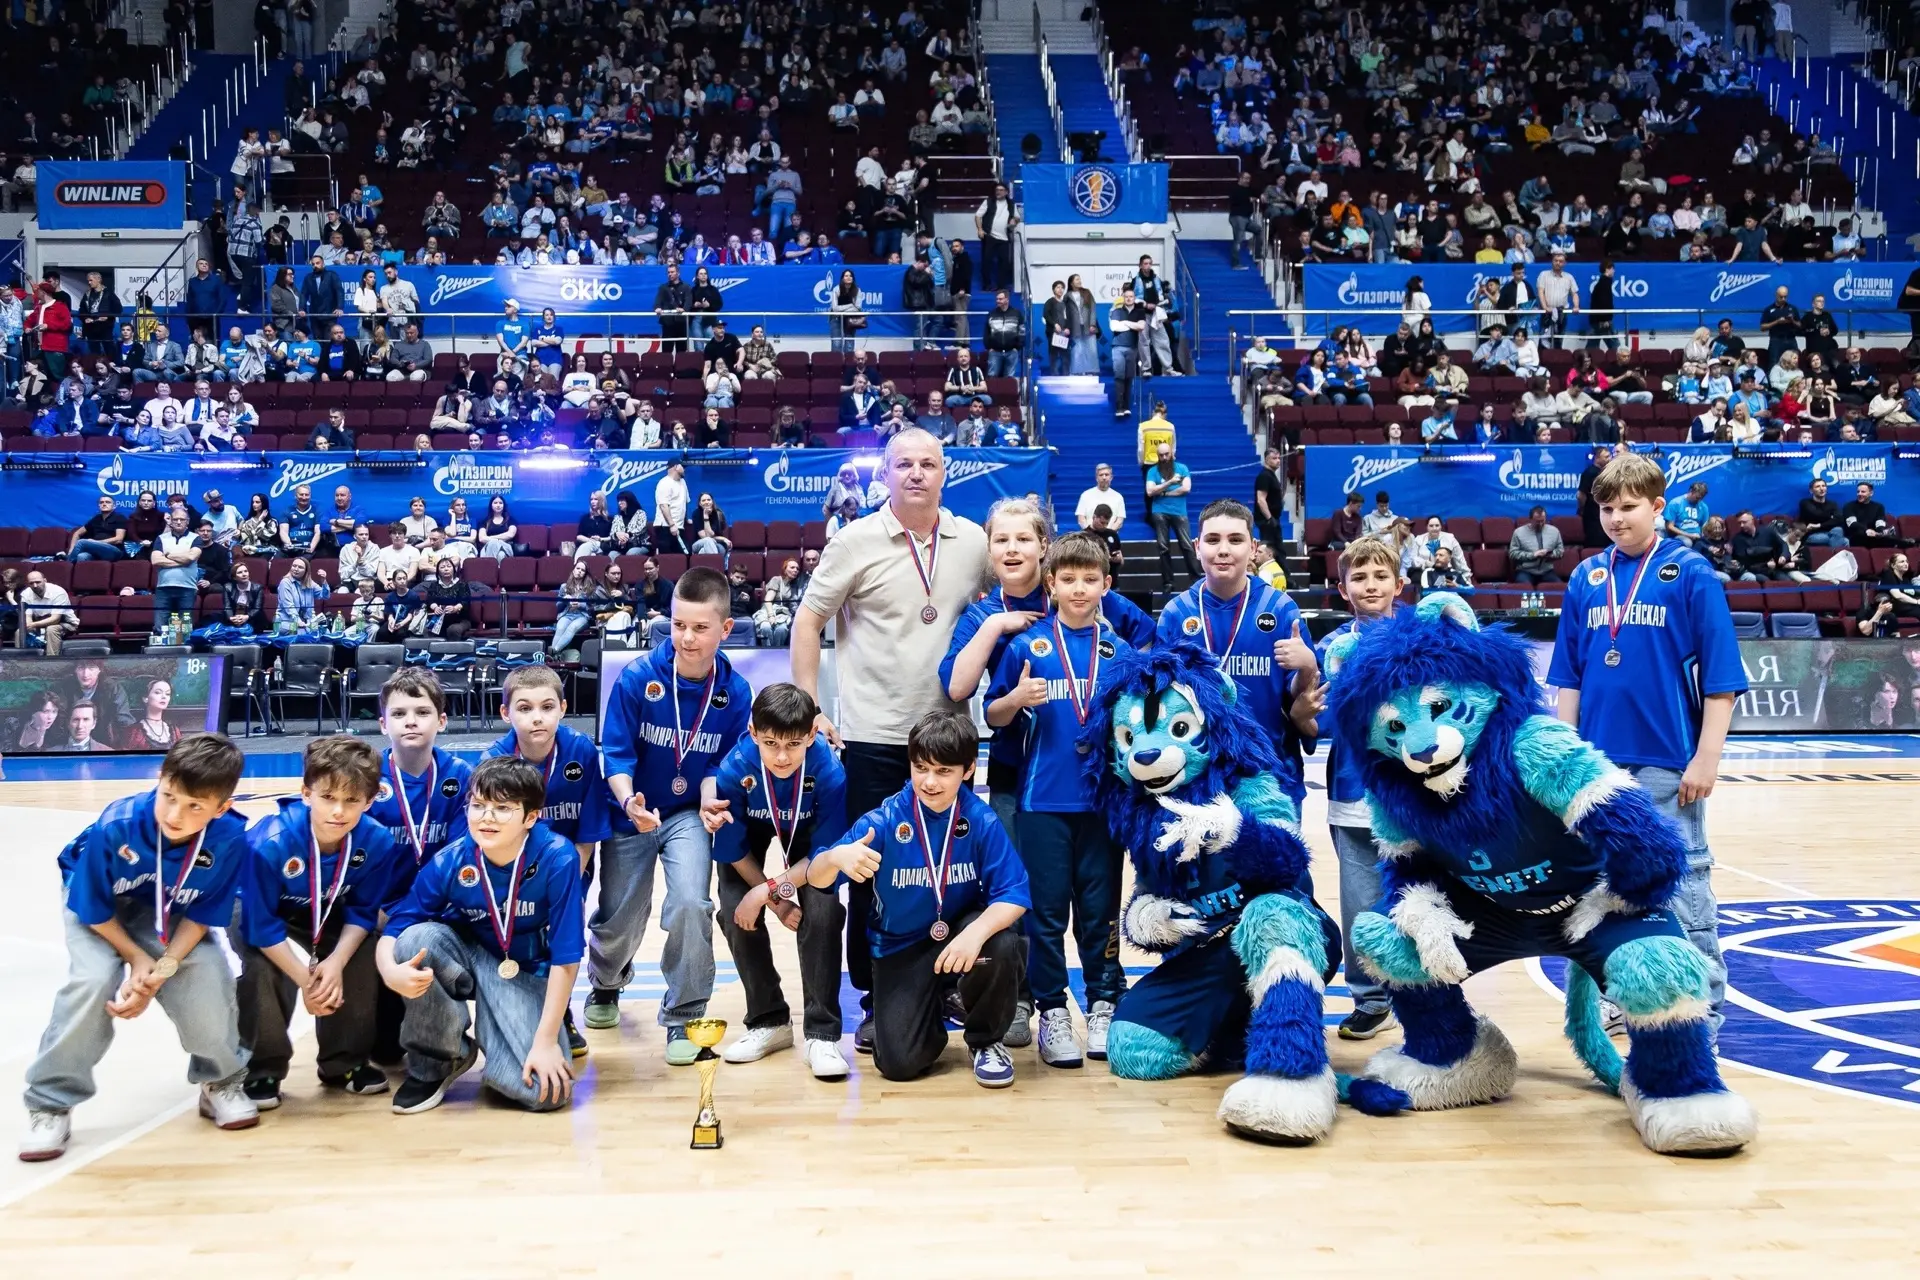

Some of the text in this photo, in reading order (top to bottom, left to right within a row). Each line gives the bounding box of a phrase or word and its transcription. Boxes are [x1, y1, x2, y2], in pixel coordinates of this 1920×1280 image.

[64, 186, 142, 201] WINLINE
[1853, 277, 1893, 289] ГАЗПРОМ
[1836, 457, 1886, 471] ГАЗПРОМ
[460, 465, 513, 480] ГАЗПРОМ
[125, 479, 189, 496] ГАЗПРОМ
[765, 496, 818, 504] ГЕНЕРАЛЬНЫЙ
[1660, 568, 1678, 576] РФБ
[1258, 618, 1275, 626] РФБ
[186, 658, 208, 675] 18+
[565, 768, 582, 776] РФБ
